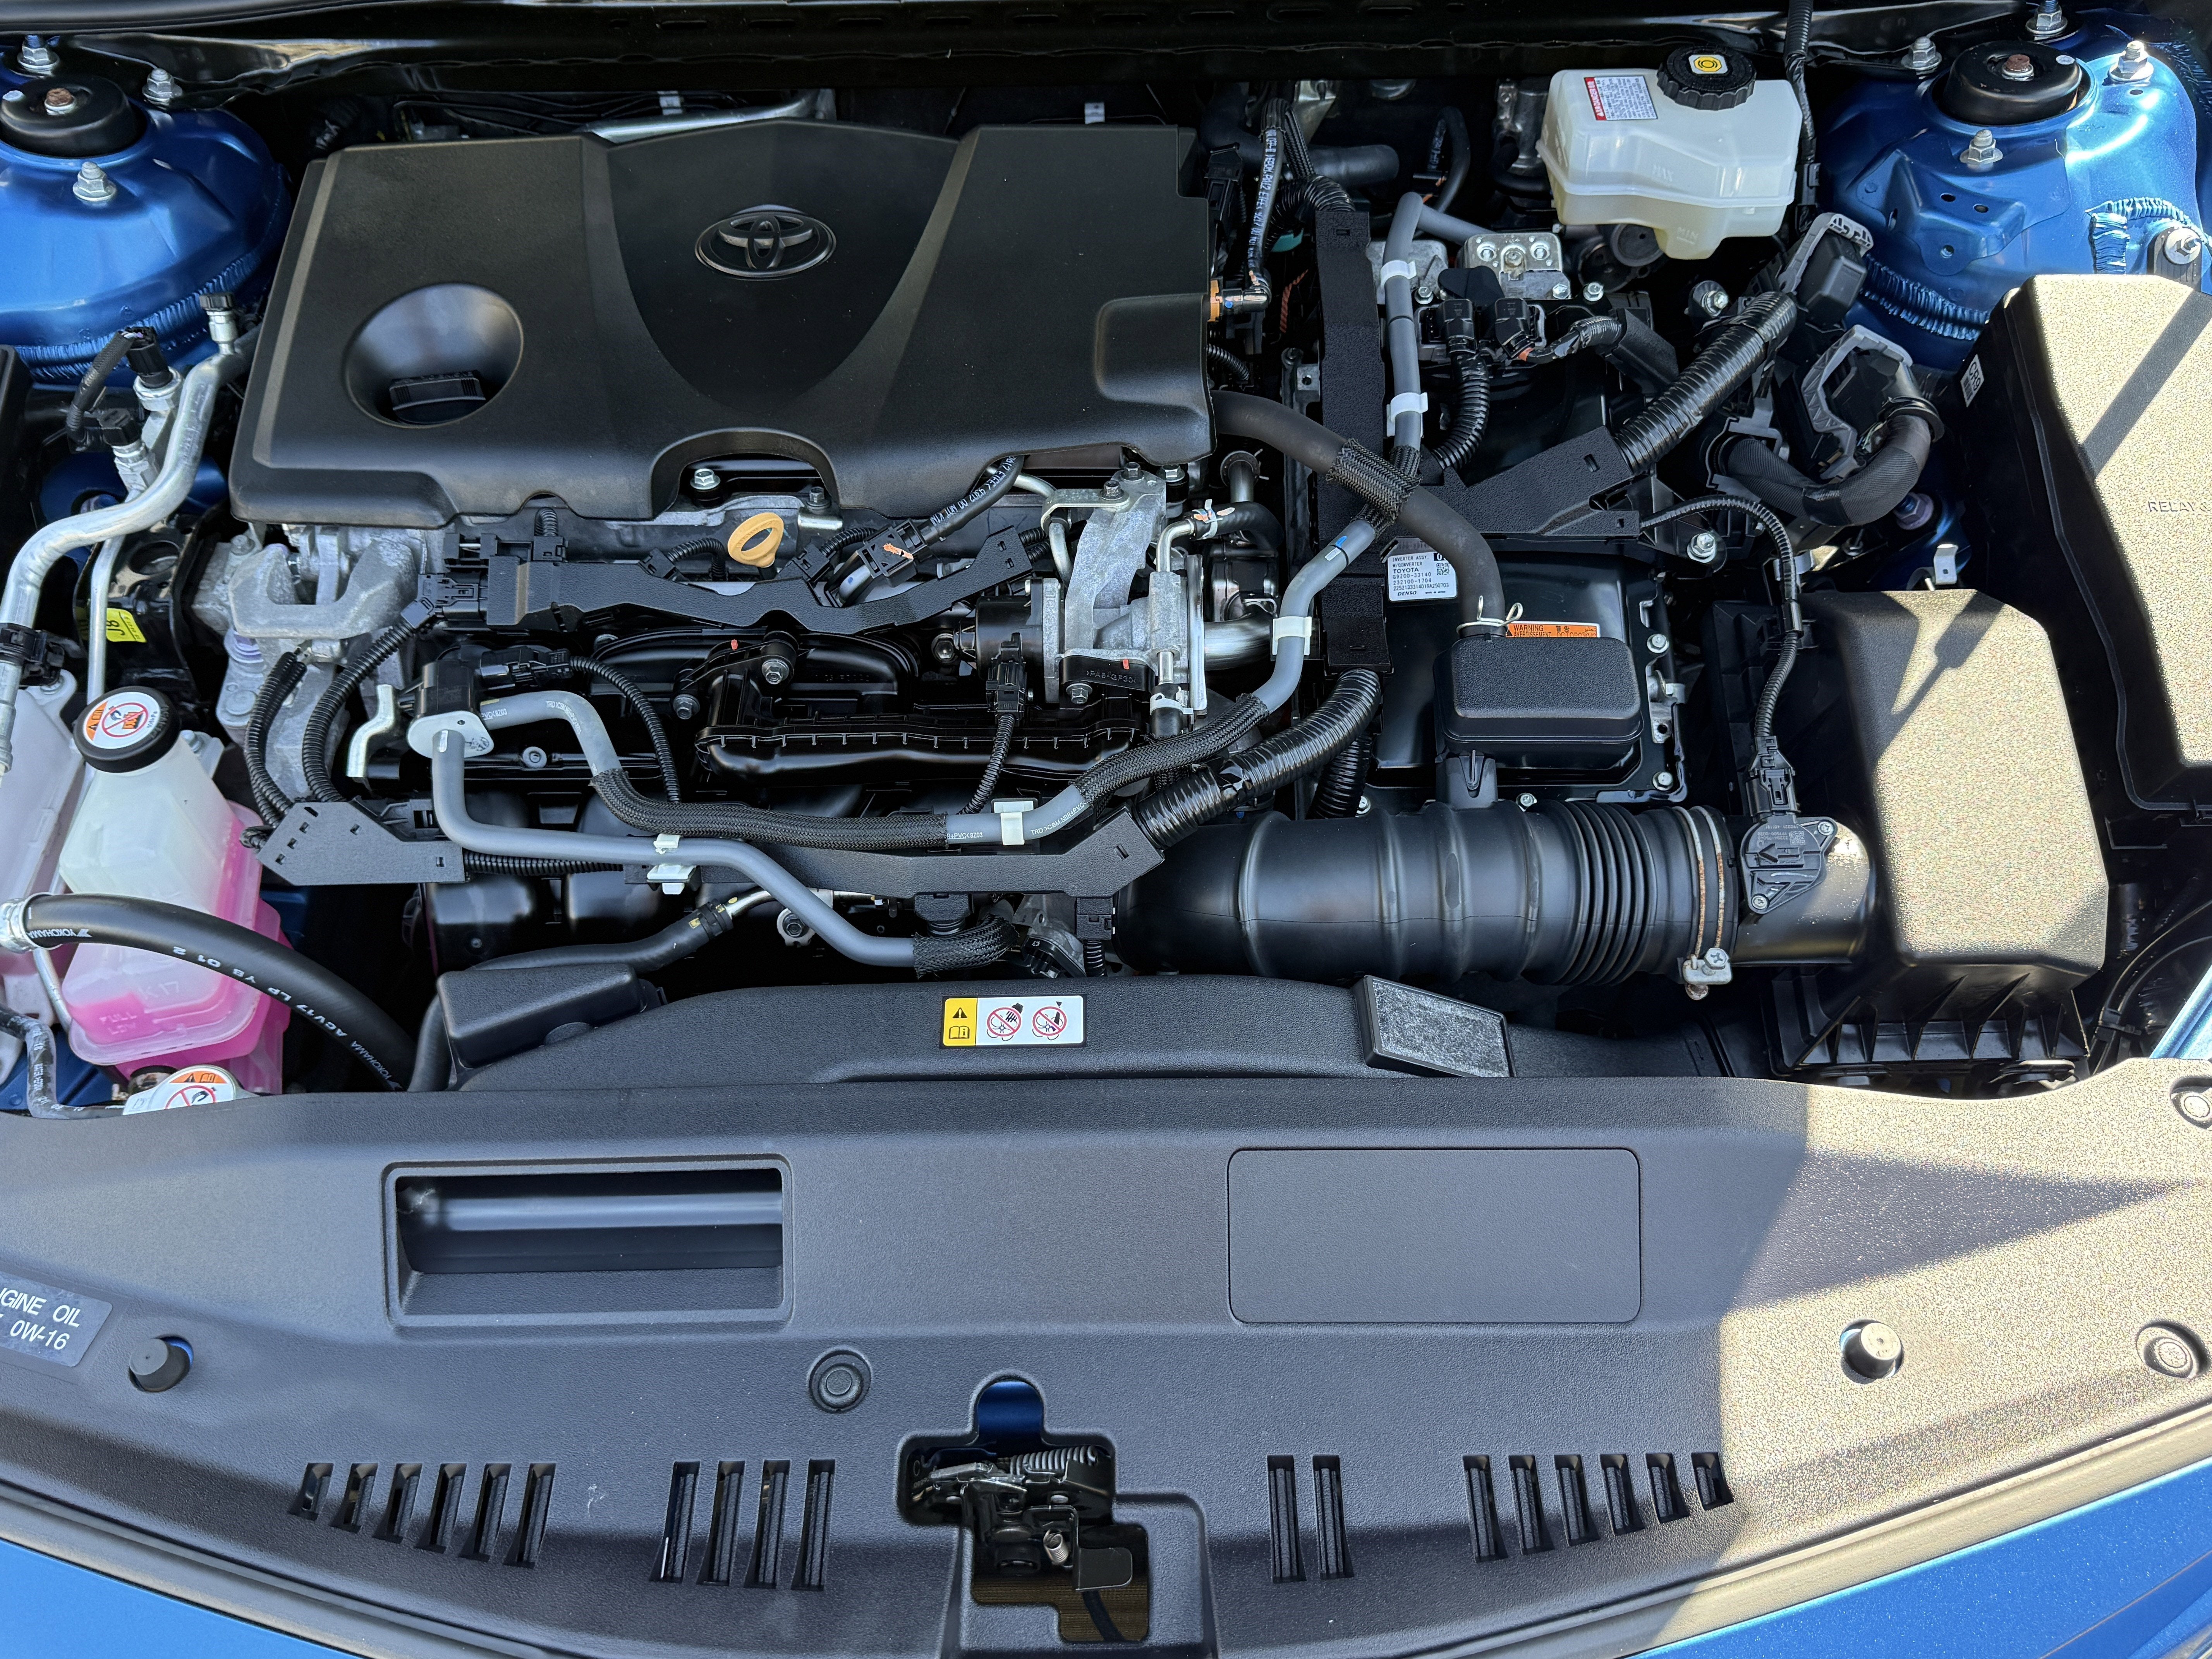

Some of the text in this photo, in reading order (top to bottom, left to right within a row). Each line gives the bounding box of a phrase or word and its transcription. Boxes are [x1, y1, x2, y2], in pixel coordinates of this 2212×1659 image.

[1969, 362, 1981, 391] CR9
[958, 499, 968, 509] DO
[2148, 501, 2195, 512] RELAY
[26, 929, 77, 939] YOKOHAMA
[268, 988, 291, 1001] LP
[99, 1012, 137, 1023] FULL
[296, 1005, 348, 1037] ACV17
[351, 1041, 392, 1079] YOKOHAMA
[53, 1305, 81, 1327] OIL
[10, 1320, 70, 1350] 0W-16
